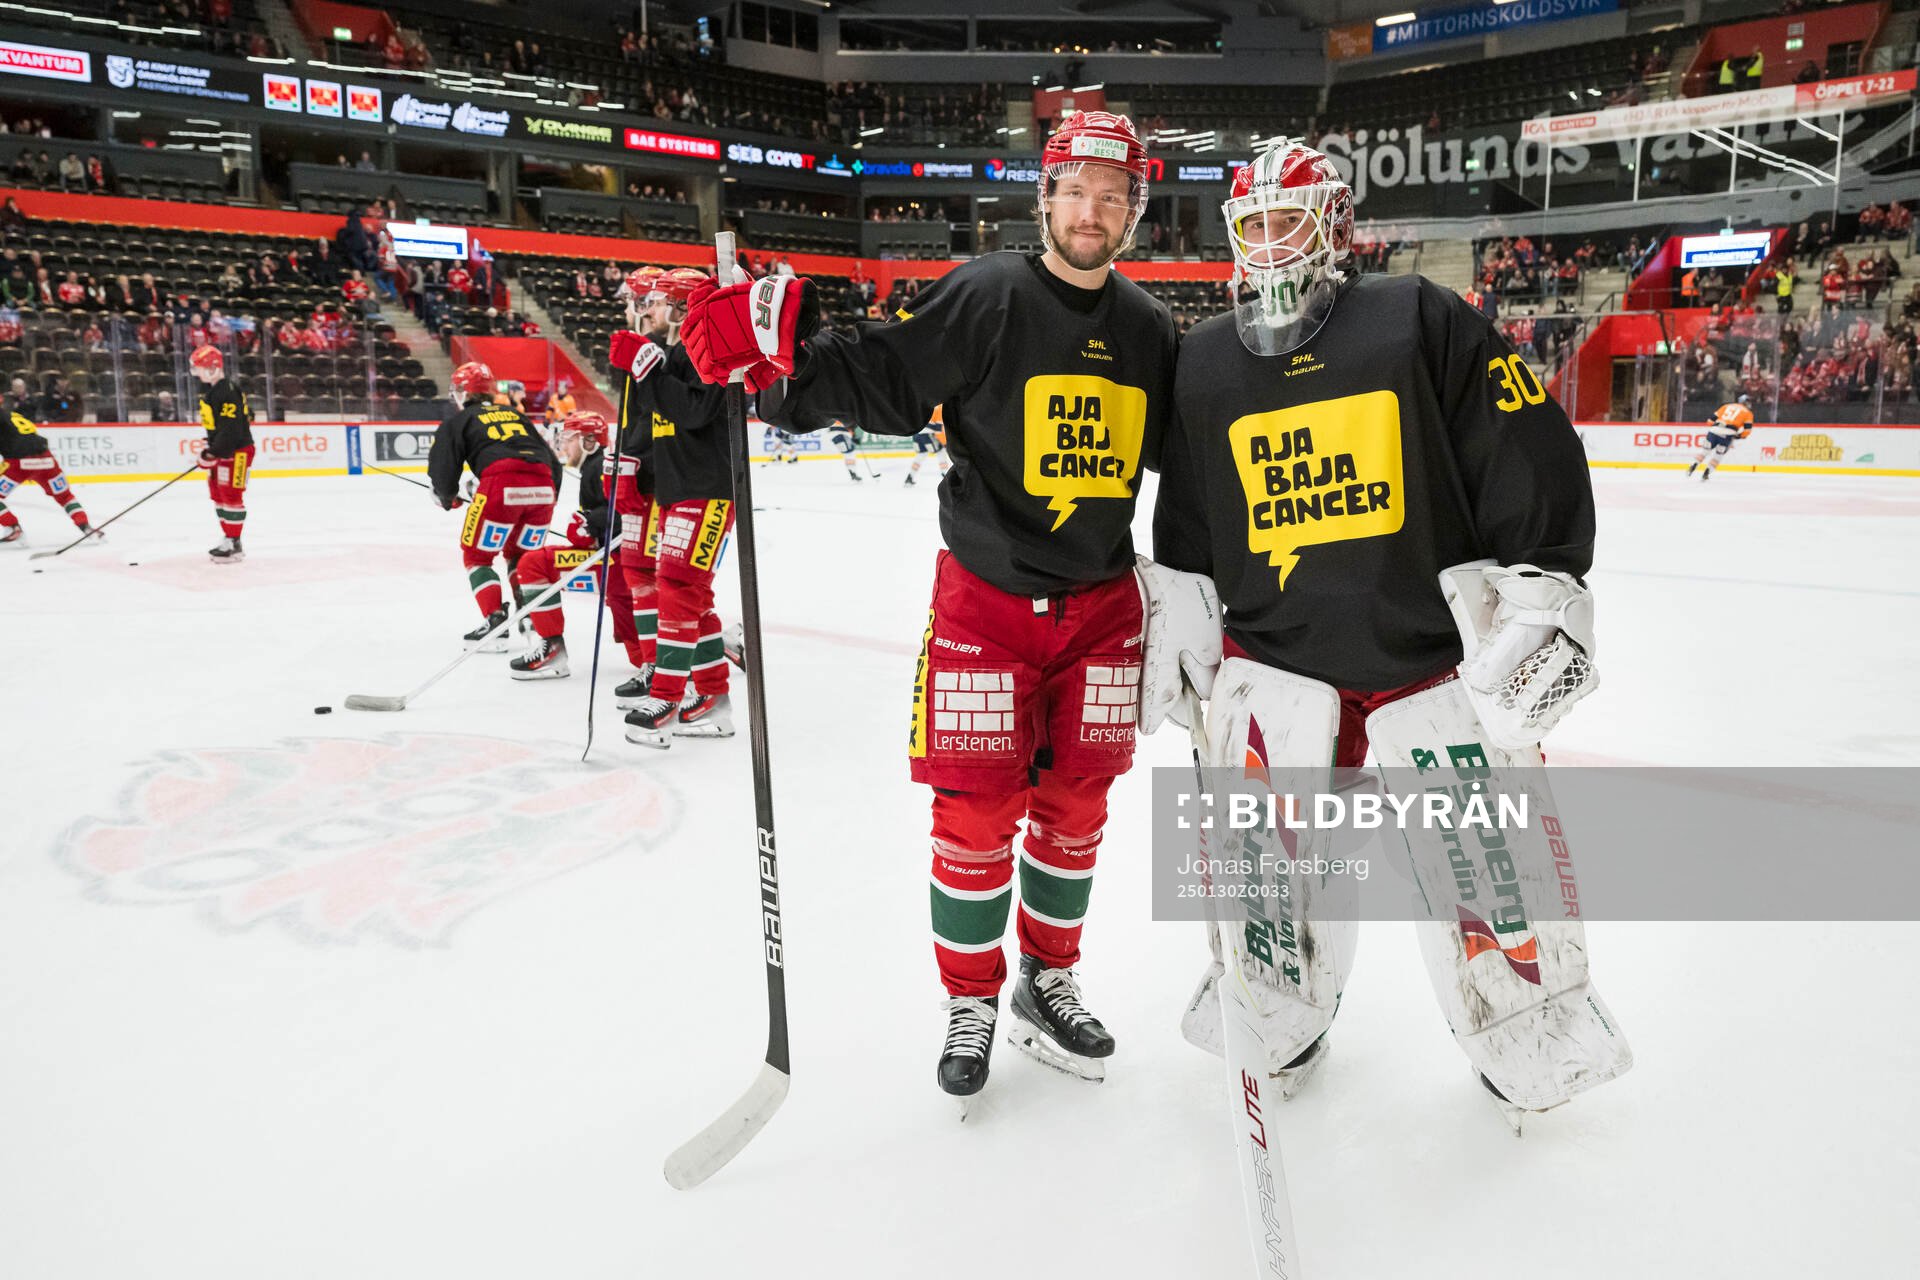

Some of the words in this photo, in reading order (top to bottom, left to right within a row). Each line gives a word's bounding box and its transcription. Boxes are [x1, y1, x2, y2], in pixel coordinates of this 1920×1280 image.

[0, 50, 80, 72] KVANTUM
[1815, 80, 1863, 99] ÖPPET
[1866, 76, 1894, 93] 7-22
[630, 133, 656, 148] BAE
[658, 136, 716, 156] SYSTEMS
[1094, 139, 1126, 150] VIMAB
[1094, 149, 1116, 158] BESS
[862, 161, 911, 176] bravida
[1088, 339, 1107, 350] SHL
[1291, 353, 1315, 366] SHL
[1488, 353, 1546, 413] 30
[220, 402, 237, 418] 32
[477, 410, 521, 425] WOODS
[1048, 394, 1101, 422] AJA
[50, 437, 114, 451] ITETS
[261, 433, 328, 453] renta
[1056, 423, 1110, 450] BAJ
[1250, 426, 1314, 465] AJA
[1264, 453, 1357, 497] BAJA
[1252, 481, 1391, 530] CANCER
[695, 500, 726, 567] Malux
[558, 552, 591, 564] Mal
